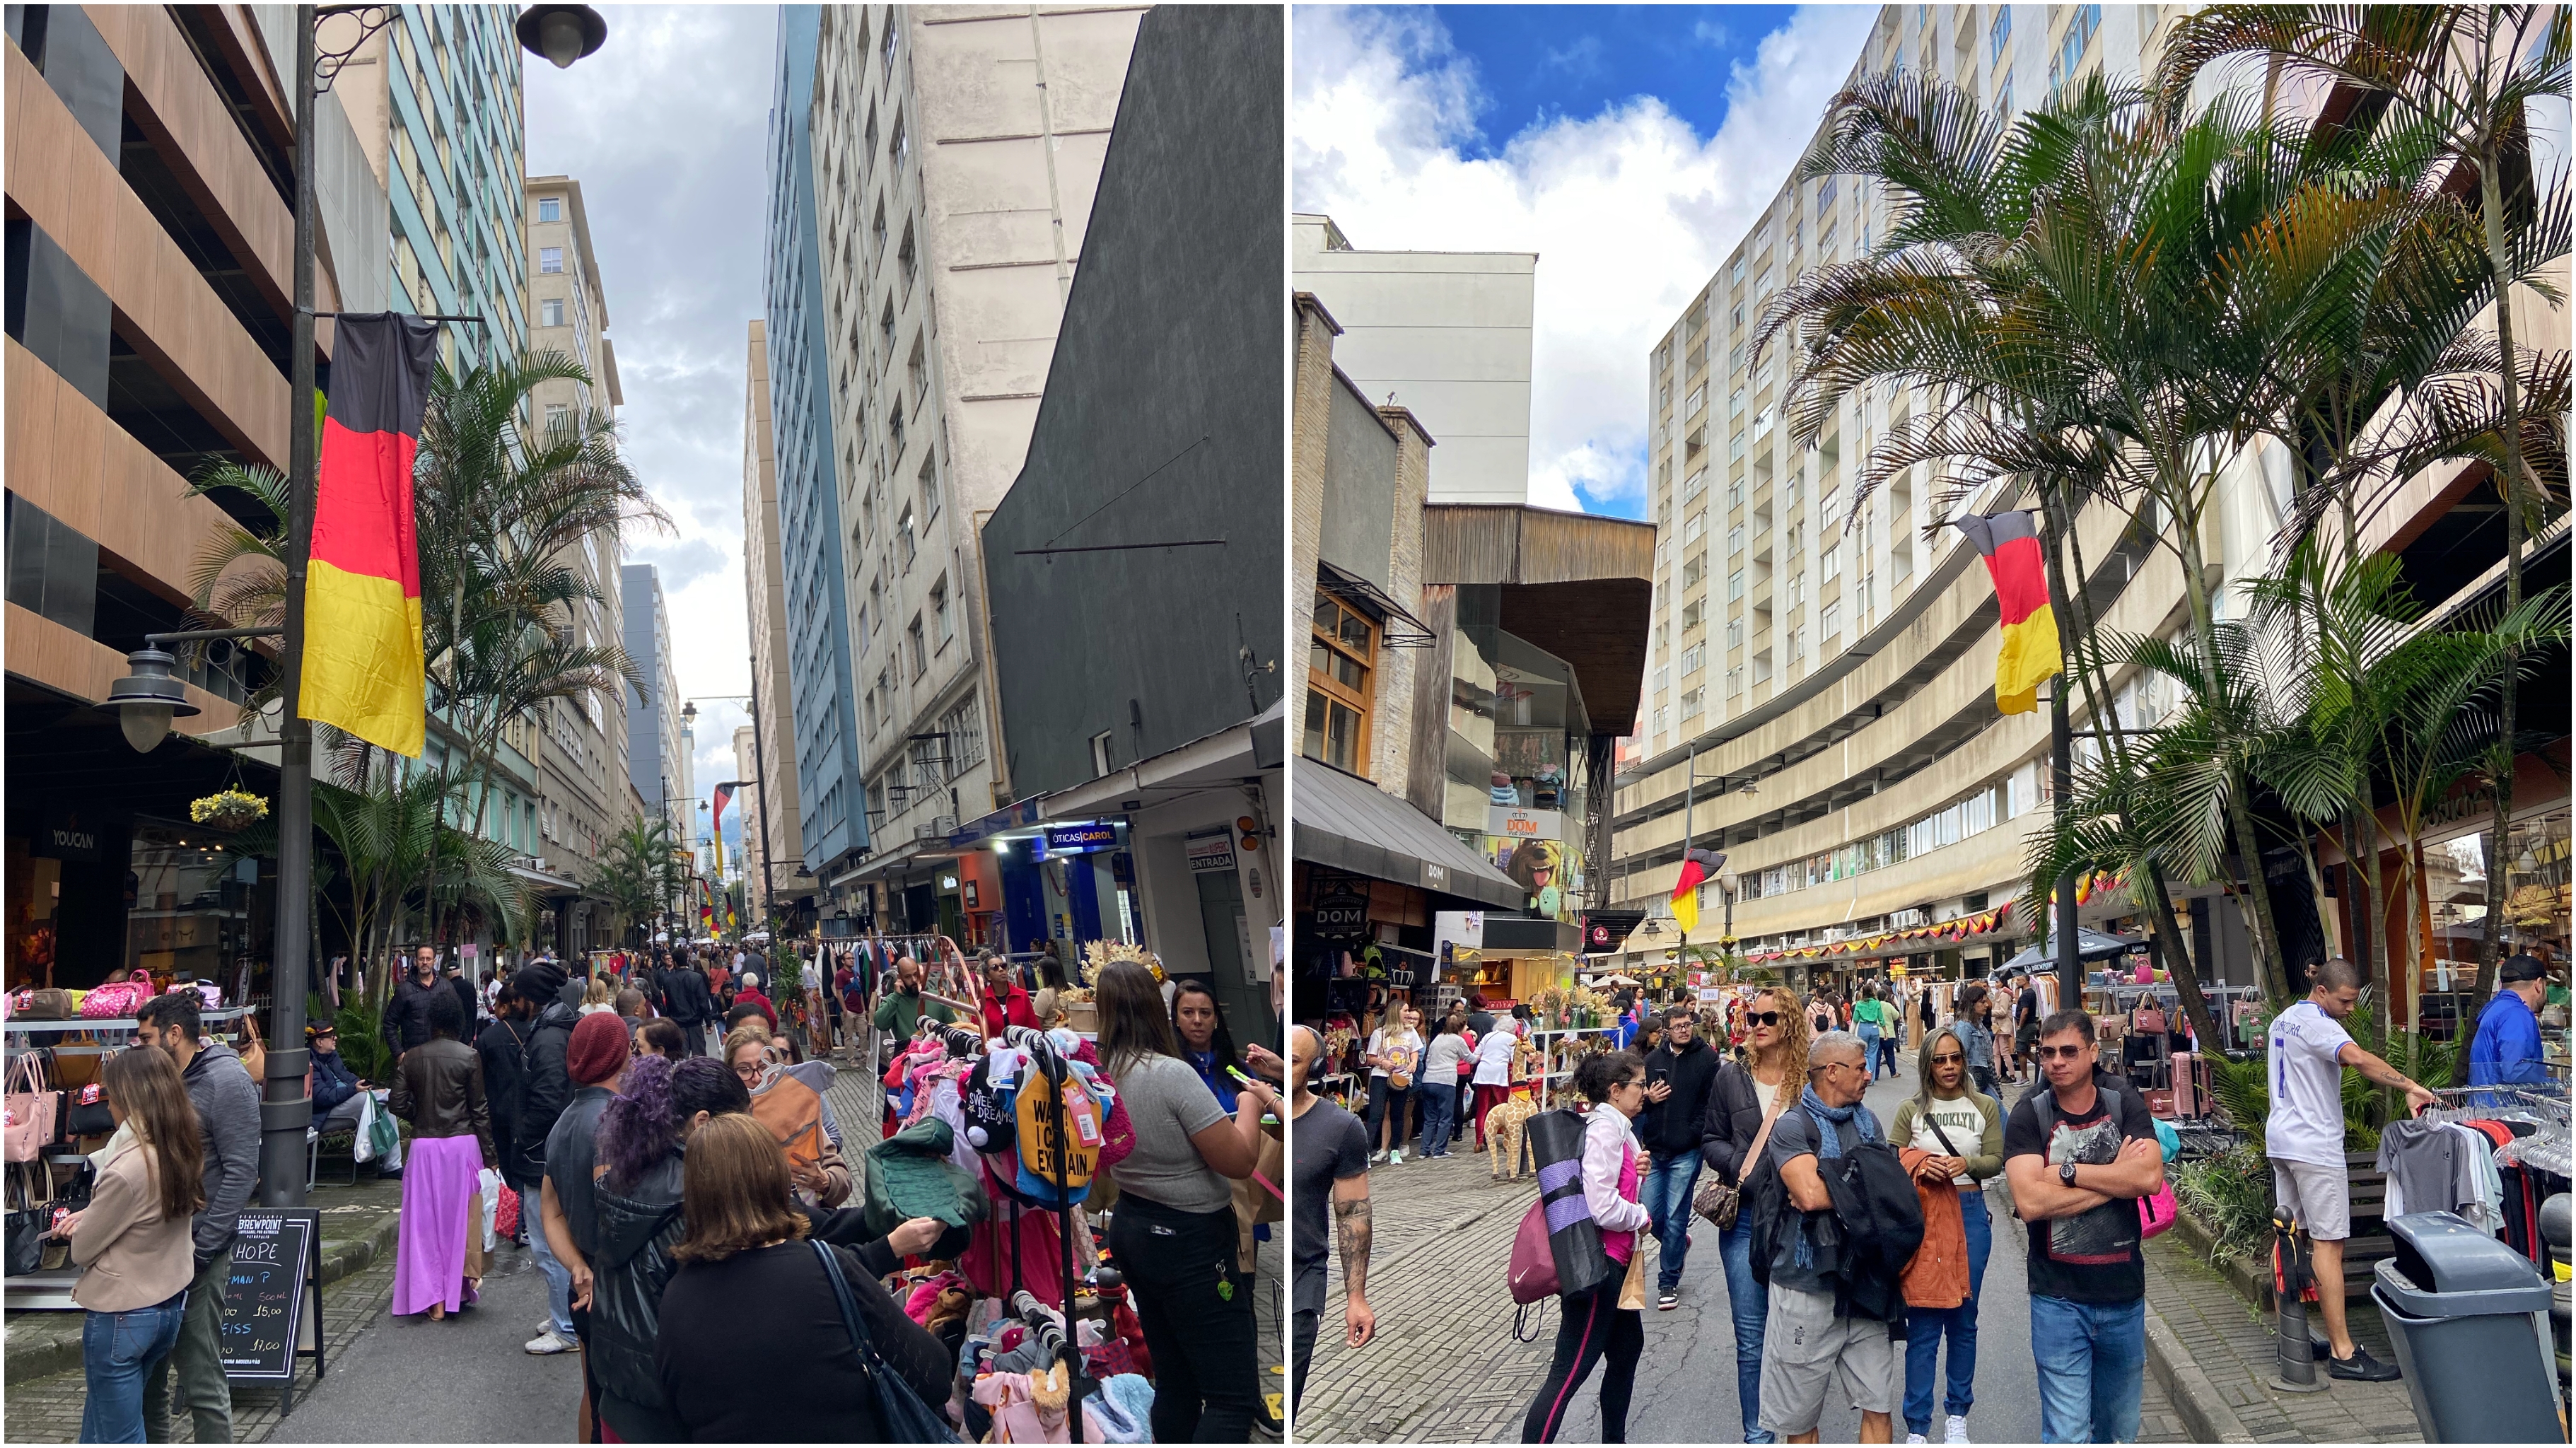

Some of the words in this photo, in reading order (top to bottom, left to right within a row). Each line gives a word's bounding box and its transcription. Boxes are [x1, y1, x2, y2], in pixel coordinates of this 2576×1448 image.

[2418, 784, 2488, 831] ostiche
[1507, 819, 1538, 833] DOM
[53, 829, 93, 848] YOUCAN
[1052, 833, 1080, 843] ÓTICAS
[1083, 831, 1114, 841] CAROL
[1190, 856, 1232, 869] ENTRADA
[1428, 864, 1444, 881] DOM
[1317, 910, 1361, 923] DOM
[2031, 962, 2054, 971] BREWPOINT
[2275, 1037, 2285, 1099] 7
[977, 1107, 1013, 1123] DREAMS
[1044, 1126, 1069, 1150] CN
[238, 1219, 283, 1230] BREWPOINT
[233, 1242, 279, 1259] HOPE
[228, 1275, 254, 1285] MAN
[260, 1271, 271, 1283] P
[252, 1304, 281, 1318] 15,00
[222, 1323, 252, 1336] EISS
[250, 1338, 280, 1352] 17,00
